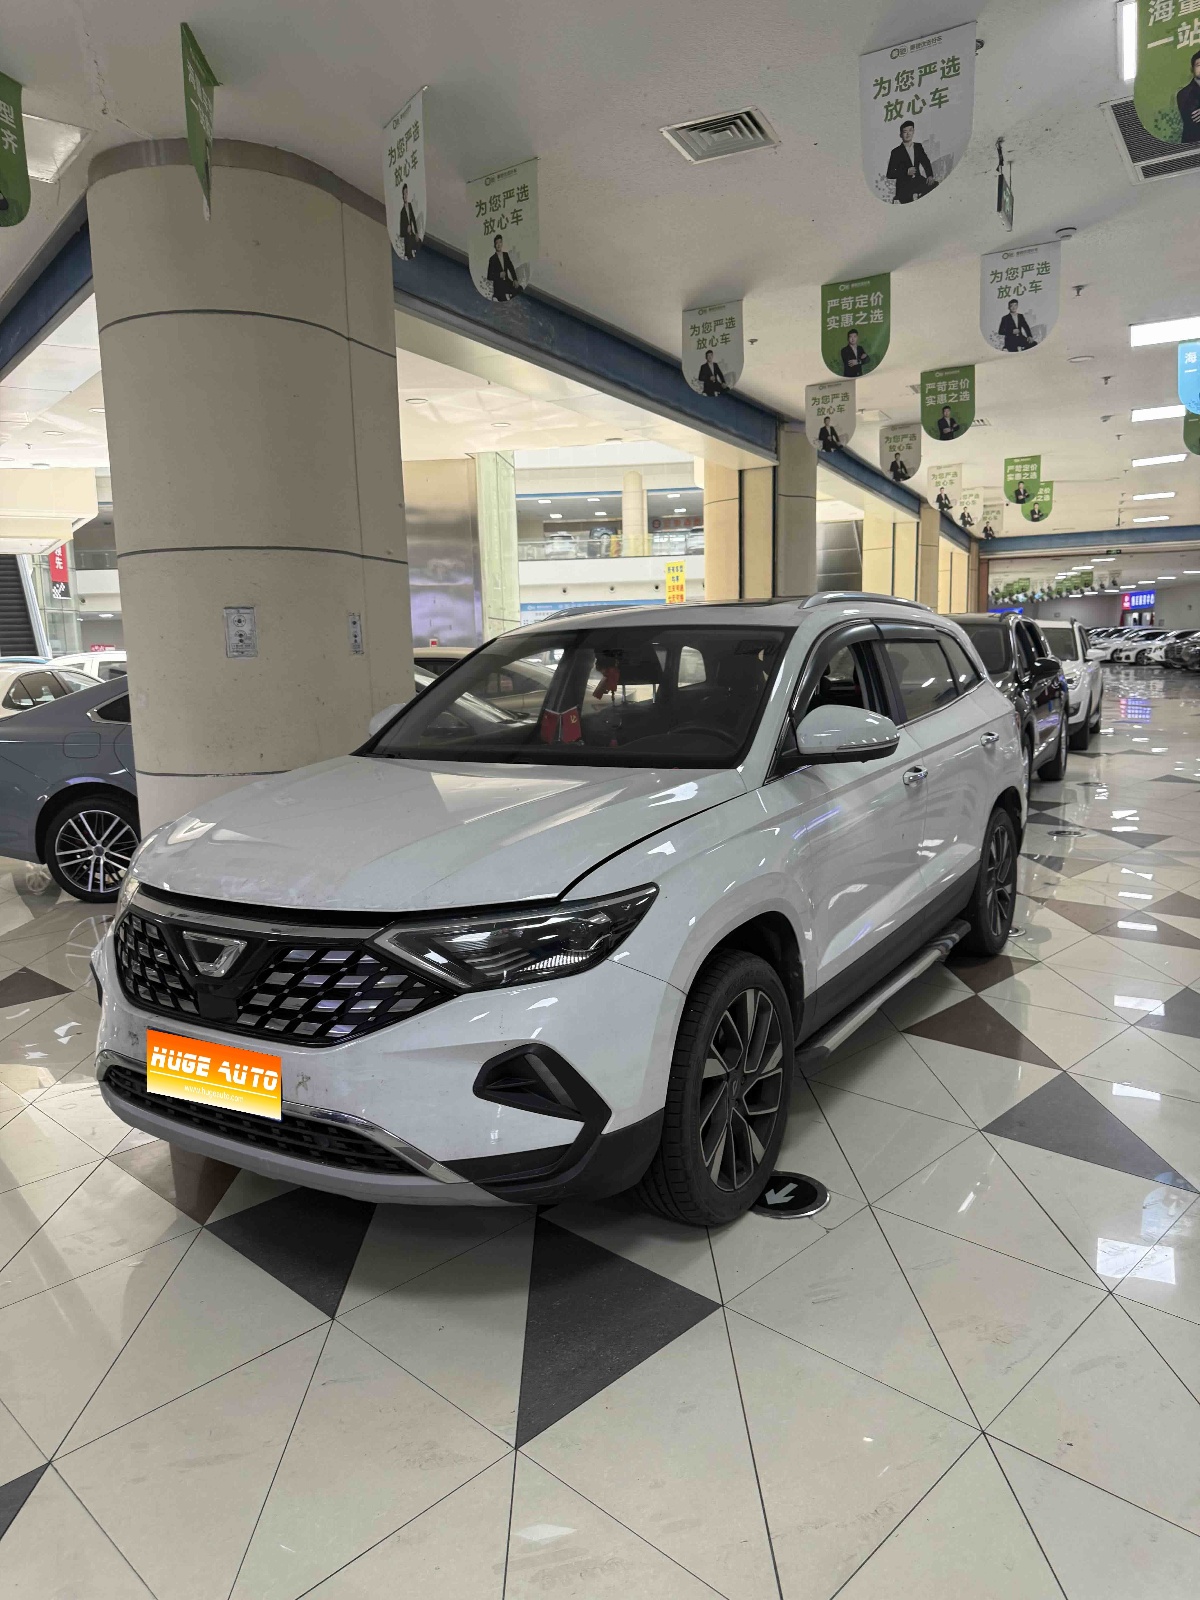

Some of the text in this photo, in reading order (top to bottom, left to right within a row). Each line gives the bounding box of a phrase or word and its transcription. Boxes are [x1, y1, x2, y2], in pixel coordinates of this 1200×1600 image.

[873, 55, 961, 100] 为您严选
[883, 87, 950, 123] 放心车
[388, 120, 420, 168] 为您严选
[394, 149, 418, 187] 放心车
[475, 183, 530, 218] 为您严选
[483, 208, 524, 236] 放心车
[990, 260, 1051, 284] 为您严选
[997, 279, 1042, 299] 放心车
[826, 291, 884, 315] 严苛定价
[689, 316, 737, 337] 为您严选
[826, 308, 884, 330] 实惠之选
[696, 335, 731, 350] 放心车
[925, 378, 970, 394] 严苛定价
[811, 392, 850, 407] 为您严选
[925, 391, 970, 406] 实惠之选
[816, 404, 846, 417] 放心车
[884, 433, 917, 445] 为您严选
[889, 442, 913, 453] 放心车
[931, 471, 958, 481] 为您严选
[1007, 464, 1038, 473] 严苛定价
[1007, 472, 1038, 481] 实惠之选
[935, 479, 955, 487] 放心车
[959, 493, 980, 501] 您严选
